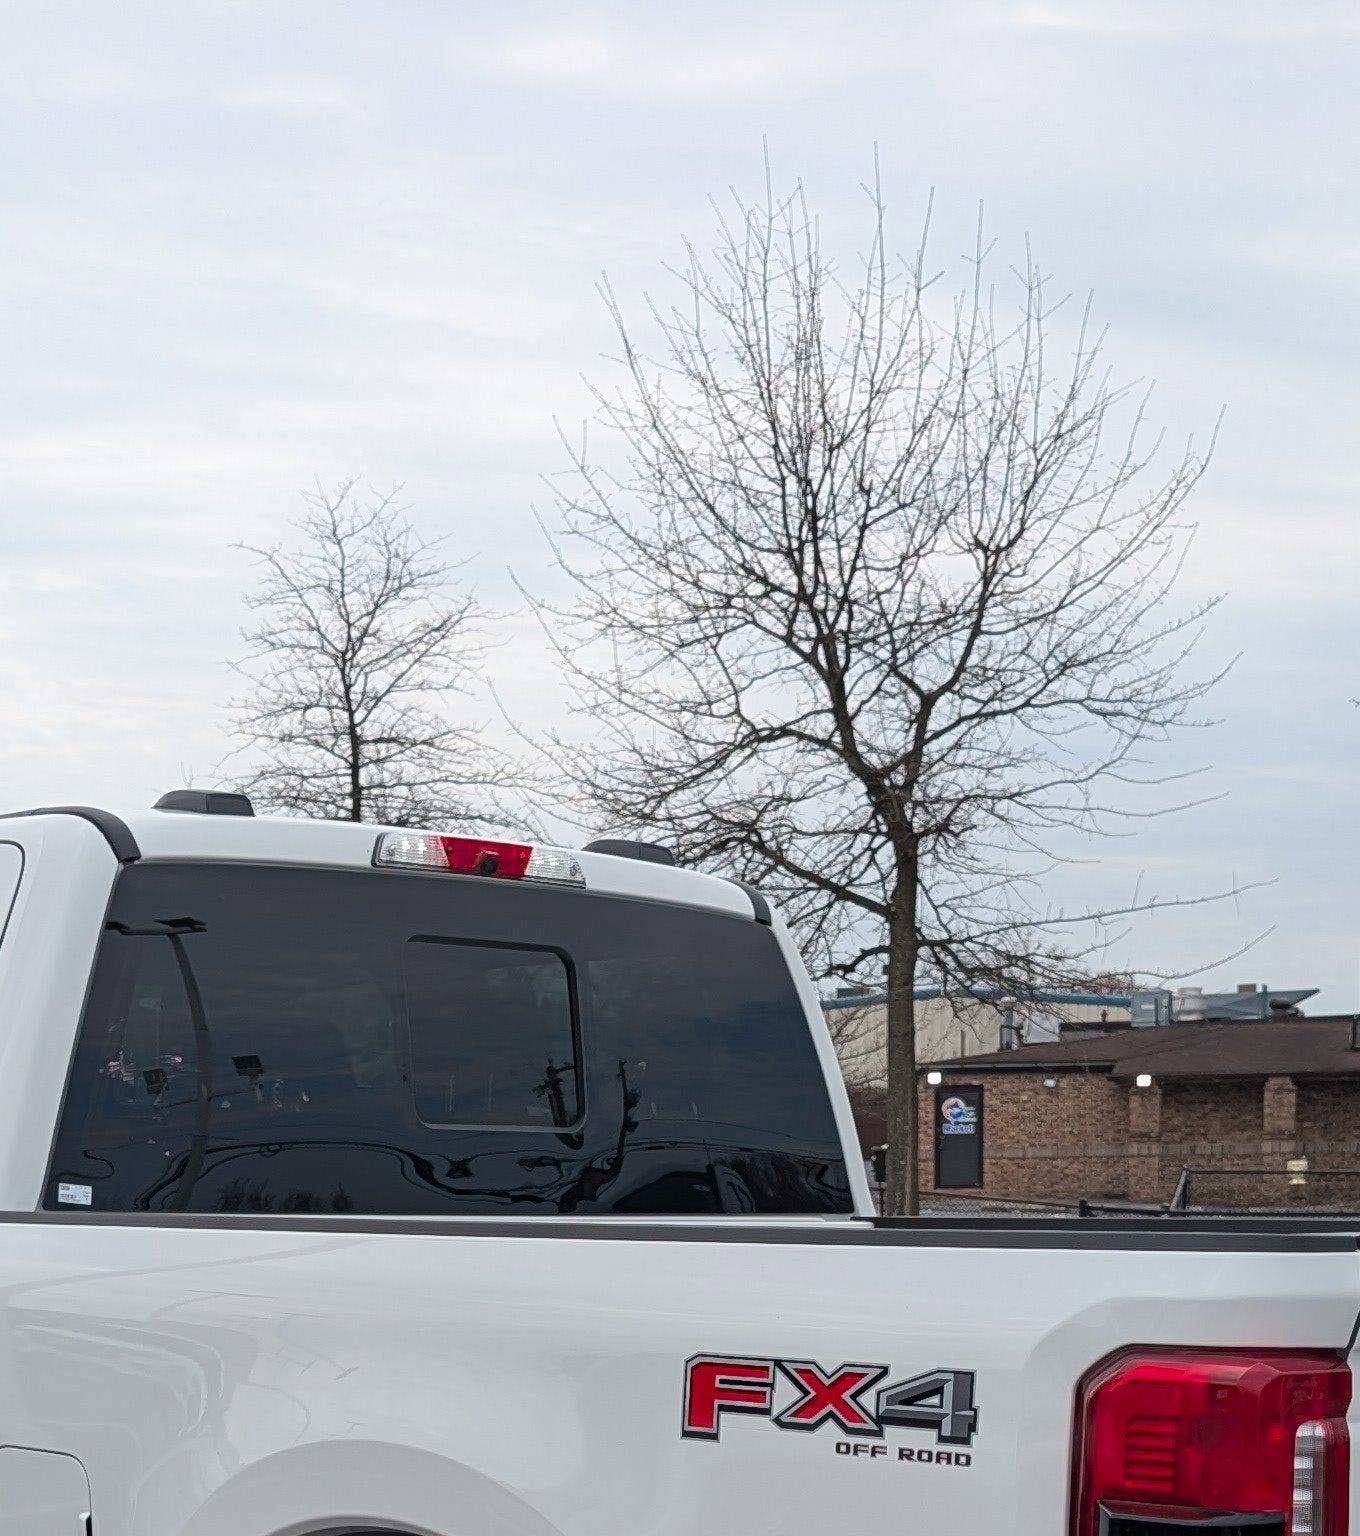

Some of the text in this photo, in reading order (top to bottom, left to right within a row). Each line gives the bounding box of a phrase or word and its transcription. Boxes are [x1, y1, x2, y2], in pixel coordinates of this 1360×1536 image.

[680, 1351, 980, 1448] FX4
[834, 1442, 972, 1467] OFF ROAD
